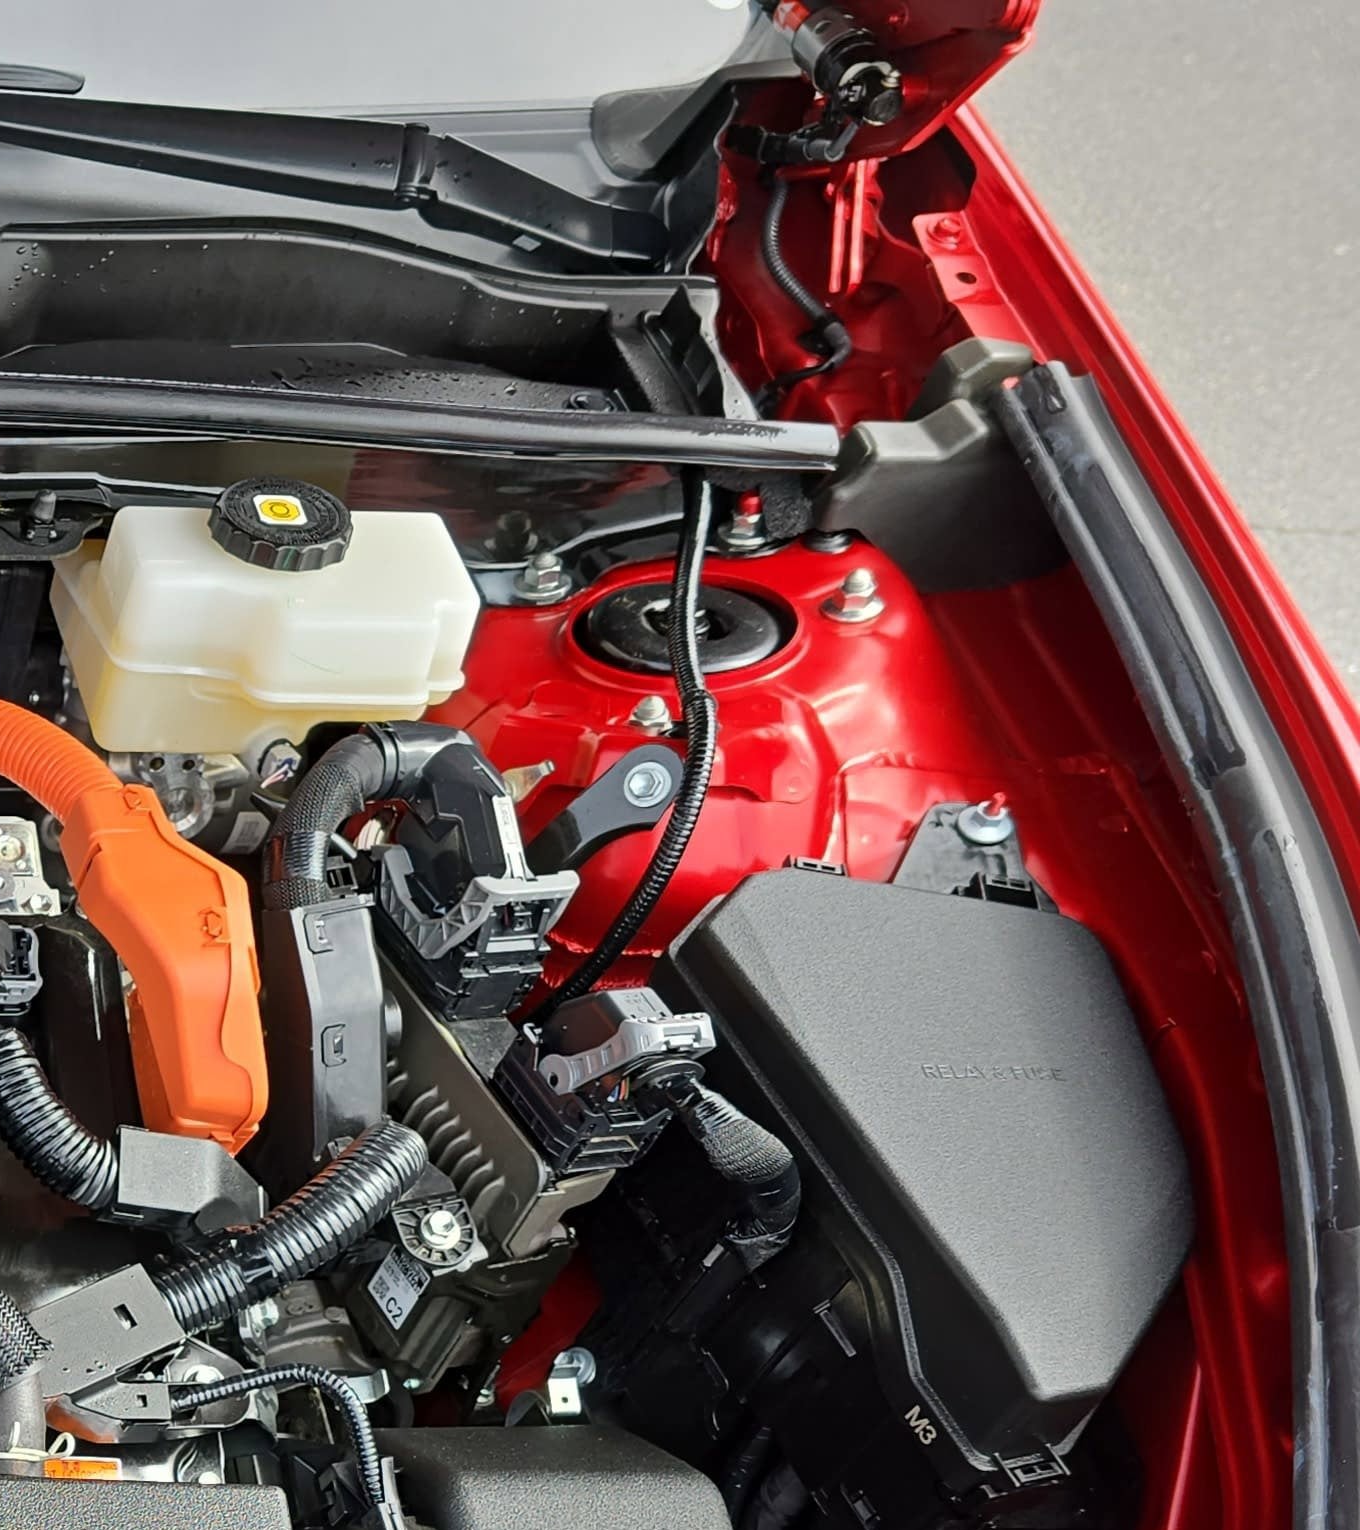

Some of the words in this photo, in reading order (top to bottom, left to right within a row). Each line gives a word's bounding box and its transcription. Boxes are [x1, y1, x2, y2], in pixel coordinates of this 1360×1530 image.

[921, 1063, 987, 1080] RELAY
[991, 1065, 1007, 1081] &
[1009, 1065, 1068, 1082] FUSE
[385, 1296, 403, 1323] C2
[904, 1404, 937, 1445] M3
